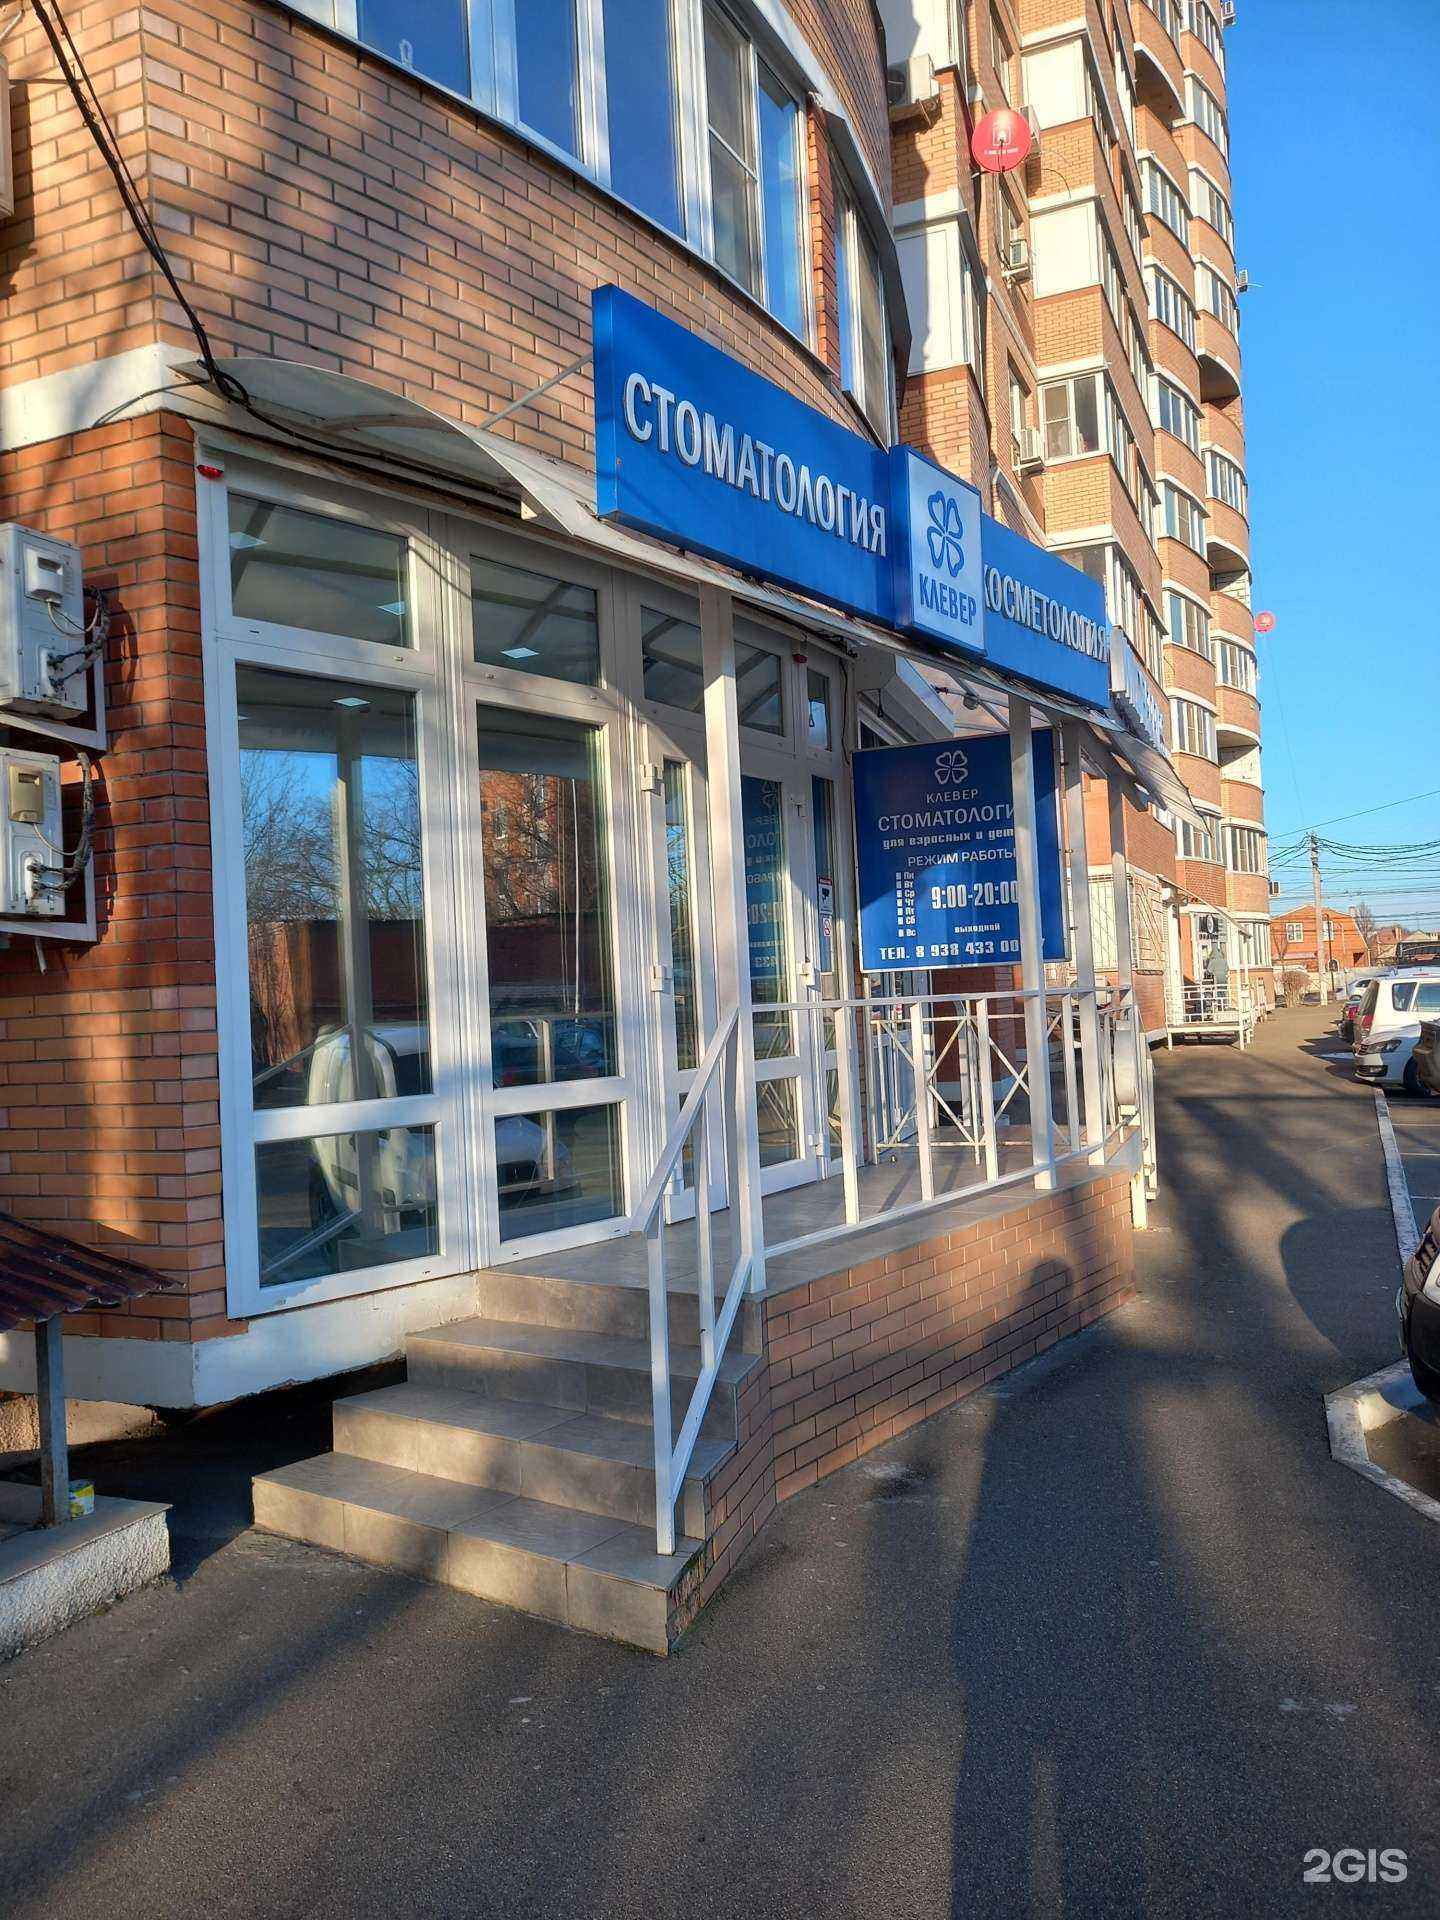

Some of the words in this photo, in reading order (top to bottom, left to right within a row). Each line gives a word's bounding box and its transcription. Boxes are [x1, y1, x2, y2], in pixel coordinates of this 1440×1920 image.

[623, 372, 887, 557] СТОМАТОЛОГИЯ
[919, 572, 977, 626] КЛЕВЕР
[926, 789, 978, 803] КЛЕВЕР
[878, 804, 1015, 831] СТОМАТОЛОГИ
[883, 838, 904, 850] для
[909, 832, 971, 847] взрослых
[976, 831, 983, 840] и
[988, 828, 1014, 840] дет
[907, 853, 959, 866] РЕЖИМ
[931, 881, 1019, 909] 9:00-20:00
[954, 923, 1000, 933] выходной
[880, 946, 910, 960] ТЕЛ.
[915, 945, 924, 958] 8
[930, 943, 959, 957] 938
[965, 940, 994, 955] 433
